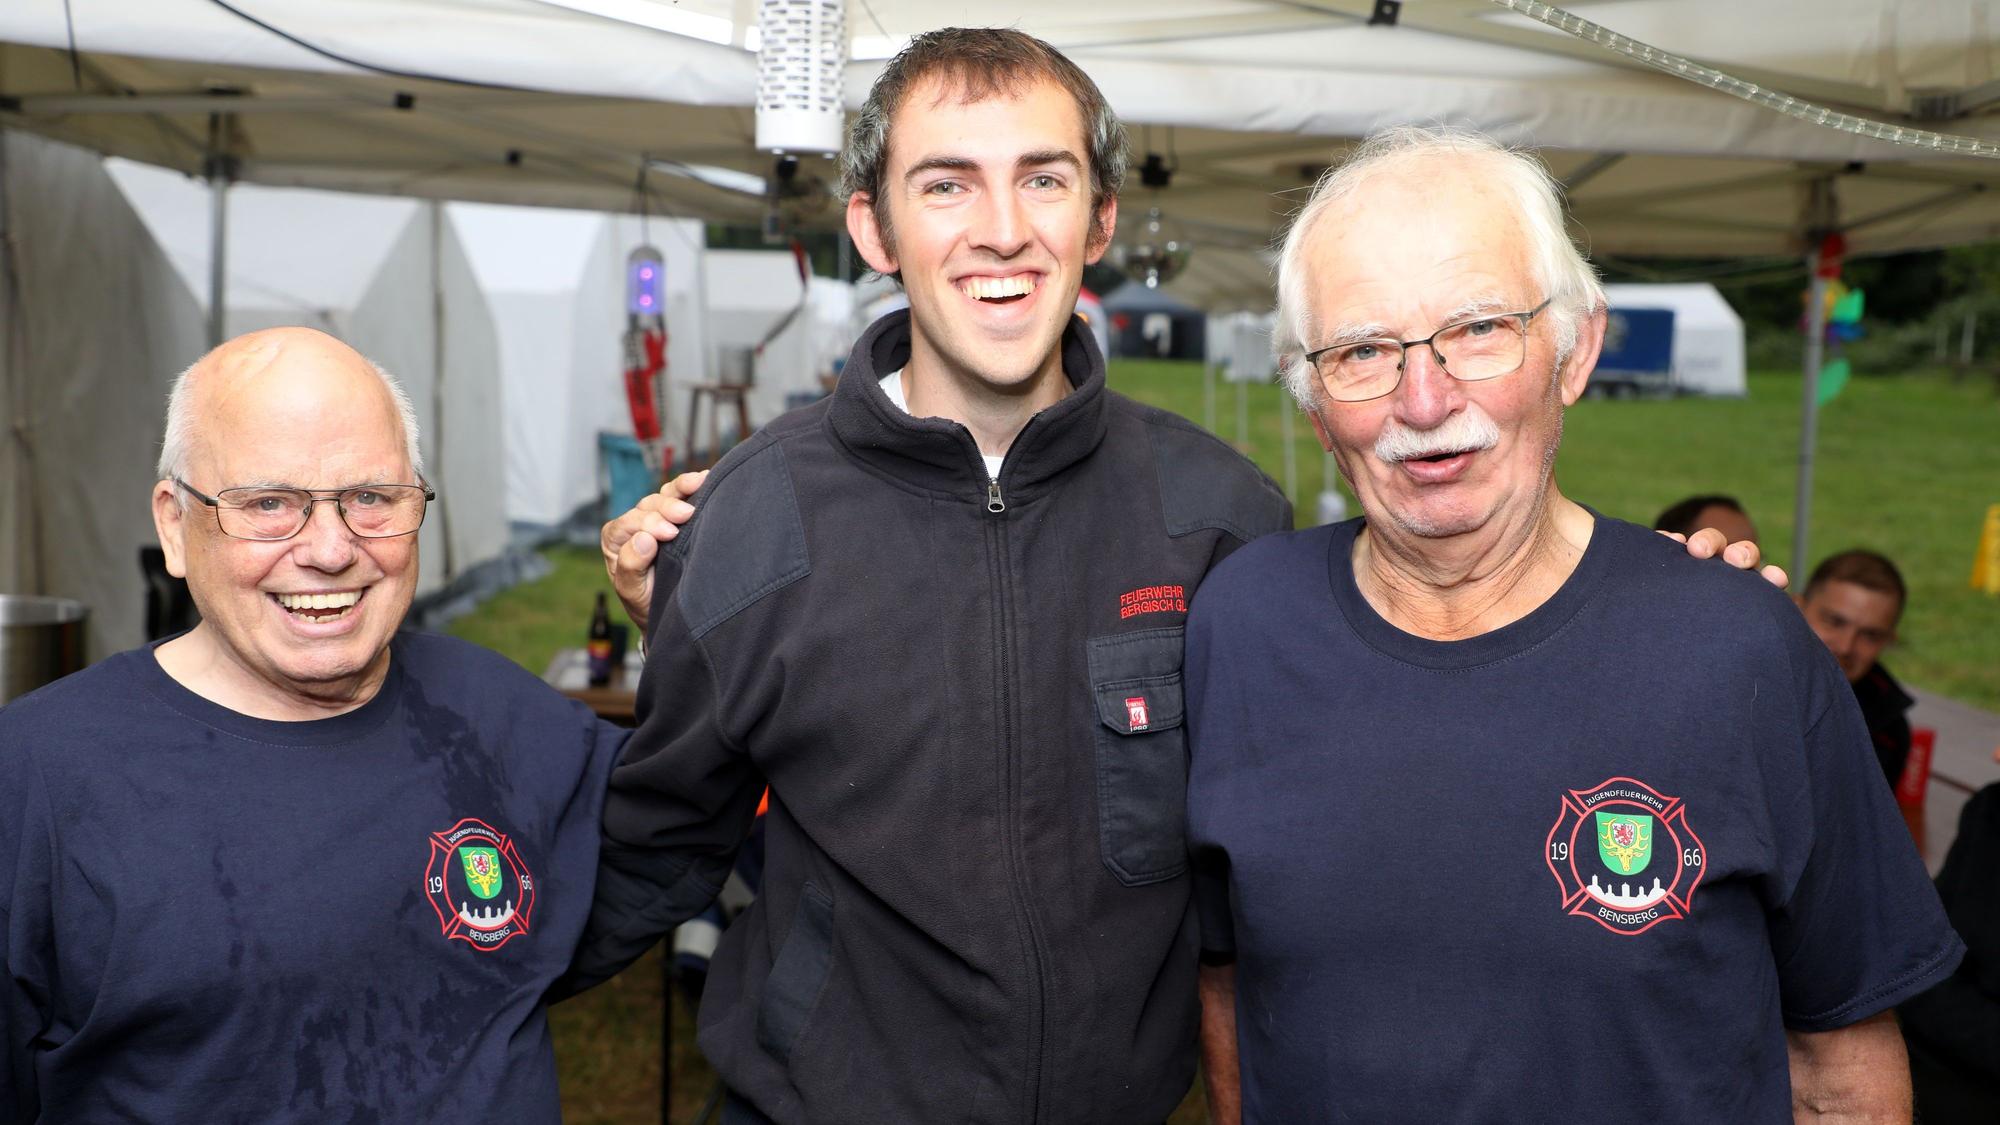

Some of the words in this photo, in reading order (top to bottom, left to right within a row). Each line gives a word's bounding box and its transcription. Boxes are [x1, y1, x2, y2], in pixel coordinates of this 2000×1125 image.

[1120, 585, 1183, 606] FEUERWEHR
[1120, 599, 1174, 619] BERGISCH
[1585, 789, 1663, 811] JUGENDFEUERWEHR
[1551, 843, 1568, 860] 19
[1683, 848, 1701, 866] 66
[428, 876, 443, 893] 19
[521, 875, 532, 890] 66
[1598, 907, 1658, 924] BENSBERG
[469, 926, 510, 942] BENSBERG
